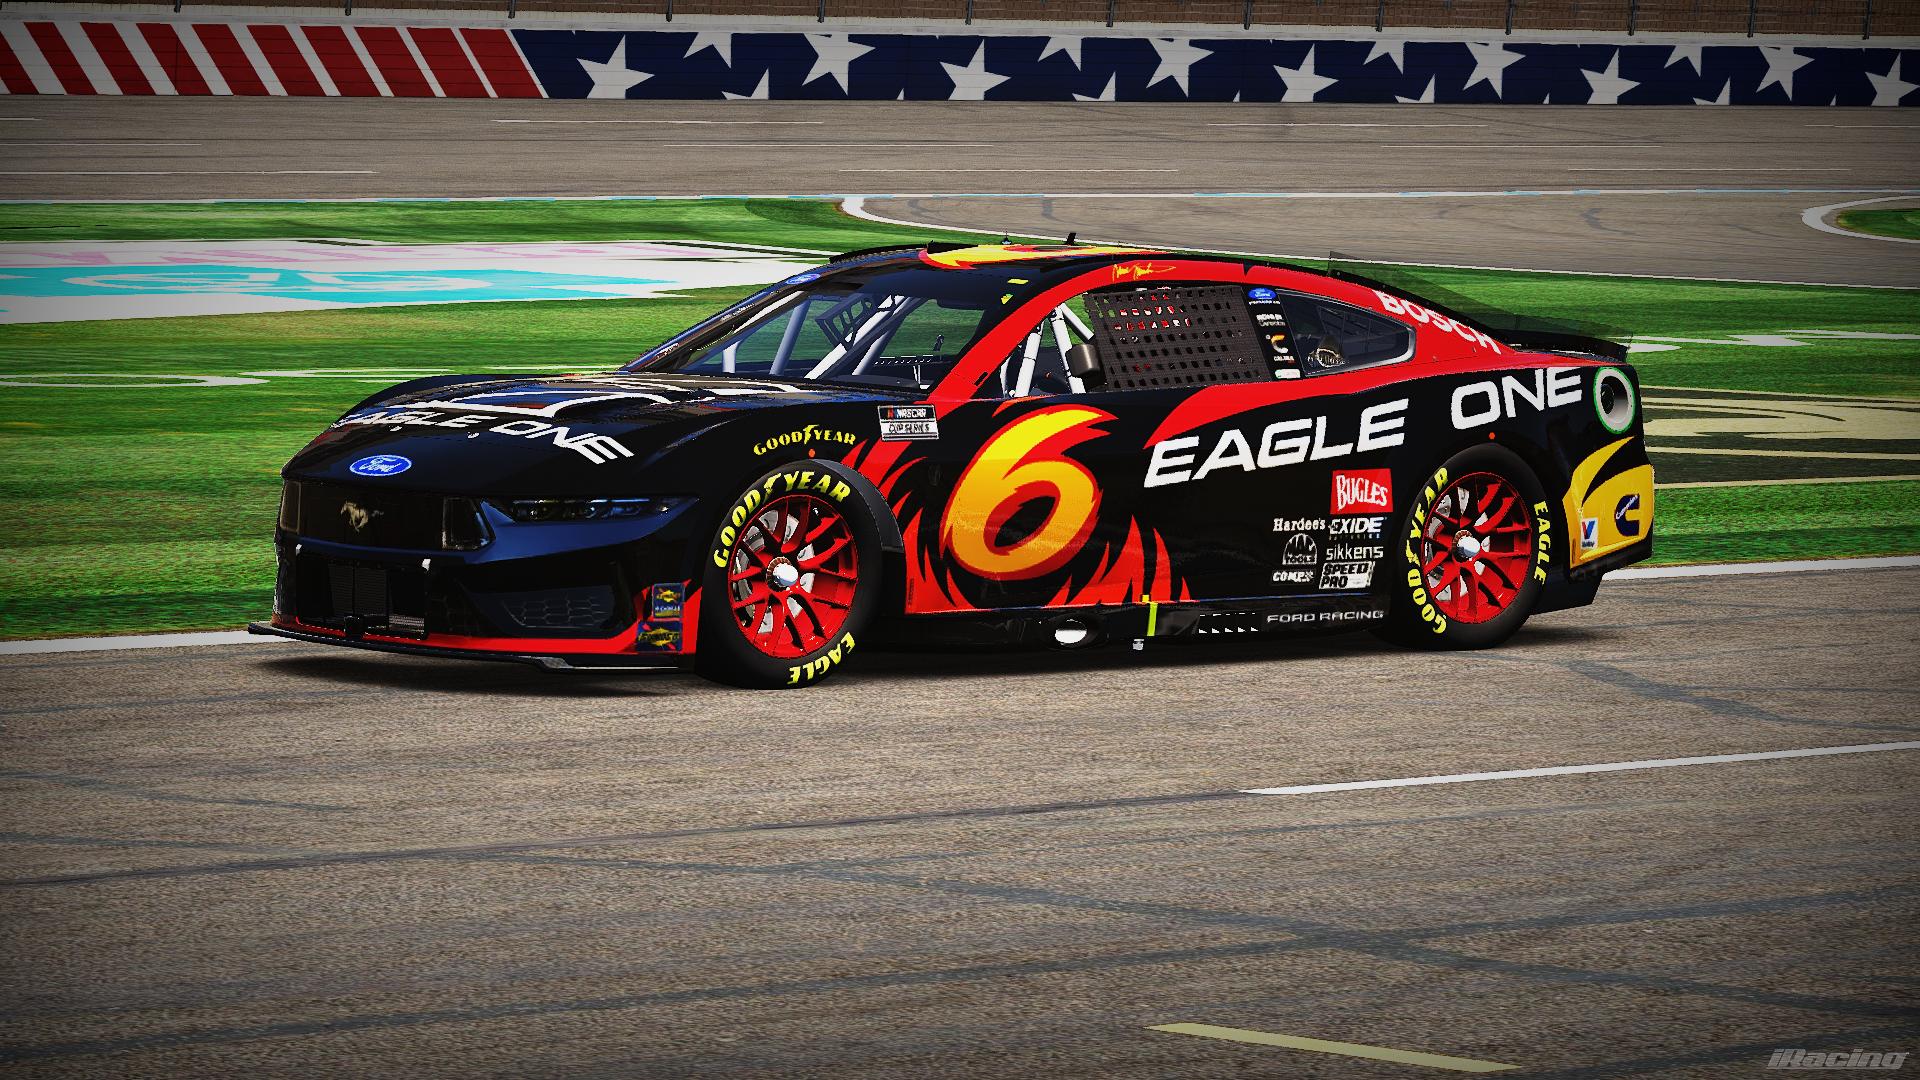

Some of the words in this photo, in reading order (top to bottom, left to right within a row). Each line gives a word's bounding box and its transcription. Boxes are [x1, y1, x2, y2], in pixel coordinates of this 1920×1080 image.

[1372, 289, 1501, 355] BOSCH
[489, 420, 635, 464] ONE
[753, 424, 856, 456] GOODYEAR
[1143, 398, 1409, 488] EAGLE
[1451, 366, 1582, 430] ONE
[359, 456, 402, 473] Ford
[939, 404, 1119, 581] 6
[1335, 475, 1388, 512] BUGLES
[714, 471, 851, 568] GOODYEAR
[1272, 517, 1326, 532] Hardee's
[1328, 517, 1385, 534] EXIDE
[1325, 542, 1384, 561] sikkens
[1406, 467, 1449, 635] GOODYEAR
[1533, 501, 1551, 585] EAGLE
[1320, 574, 1349, 589] PRO
[1323, 562, 1369, 576] SPEED
[1267, 614, 1315, 623] FORD
[1319, 610, 1384, 621] RACING
[787, 632, 856, 685] EAGLE
